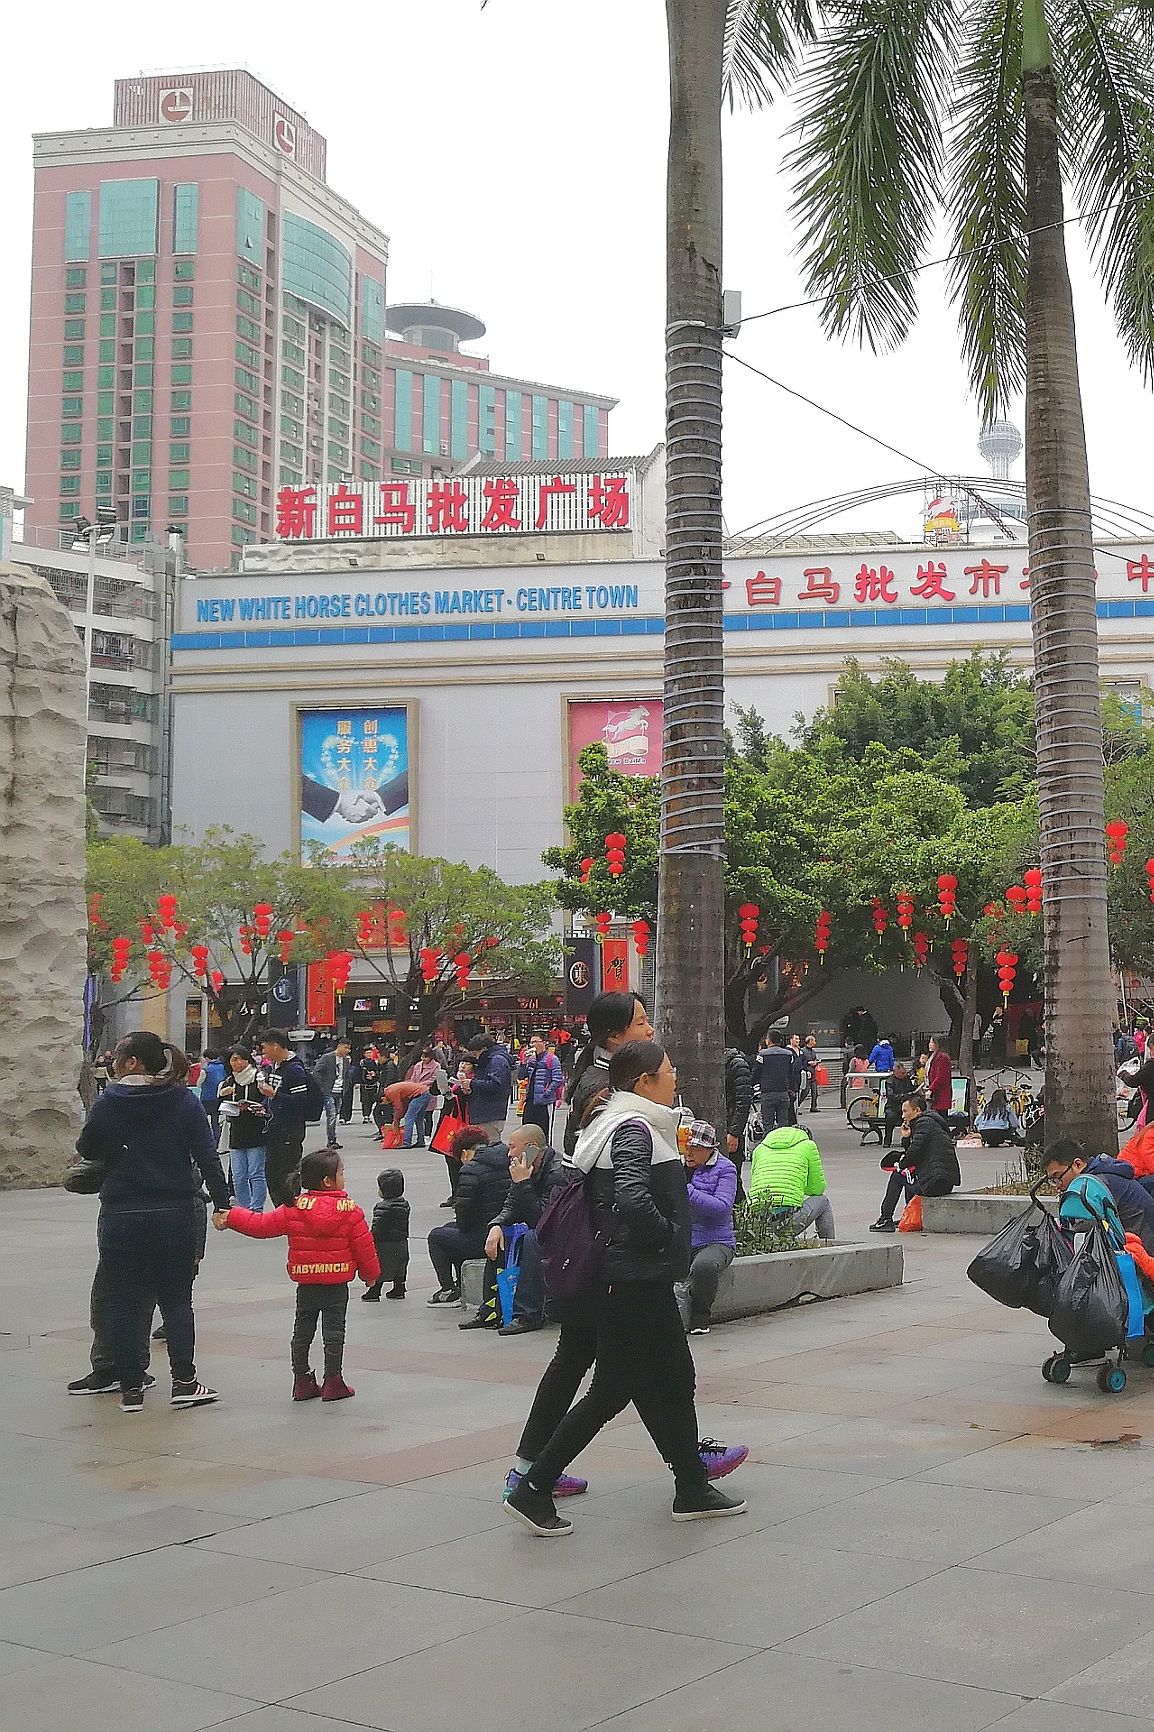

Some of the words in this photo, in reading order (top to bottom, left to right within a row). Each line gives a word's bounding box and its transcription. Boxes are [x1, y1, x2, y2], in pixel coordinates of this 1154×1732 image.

[276, 475, 629, 538] 新白马批发广场
[197, 599, 235, 622] NEW
[238, 596, 291, 621] WHITE
[294, 594, 351, 619] HORSE
[354, 591, 431, 617] CLOTHES
[434, 588, 504, 614] MARKET
[516, 586, 582, 612] CENTRE
[586, 584, 638, 609] TOWN
[721, 558, 1031, 606] 白马批发市
